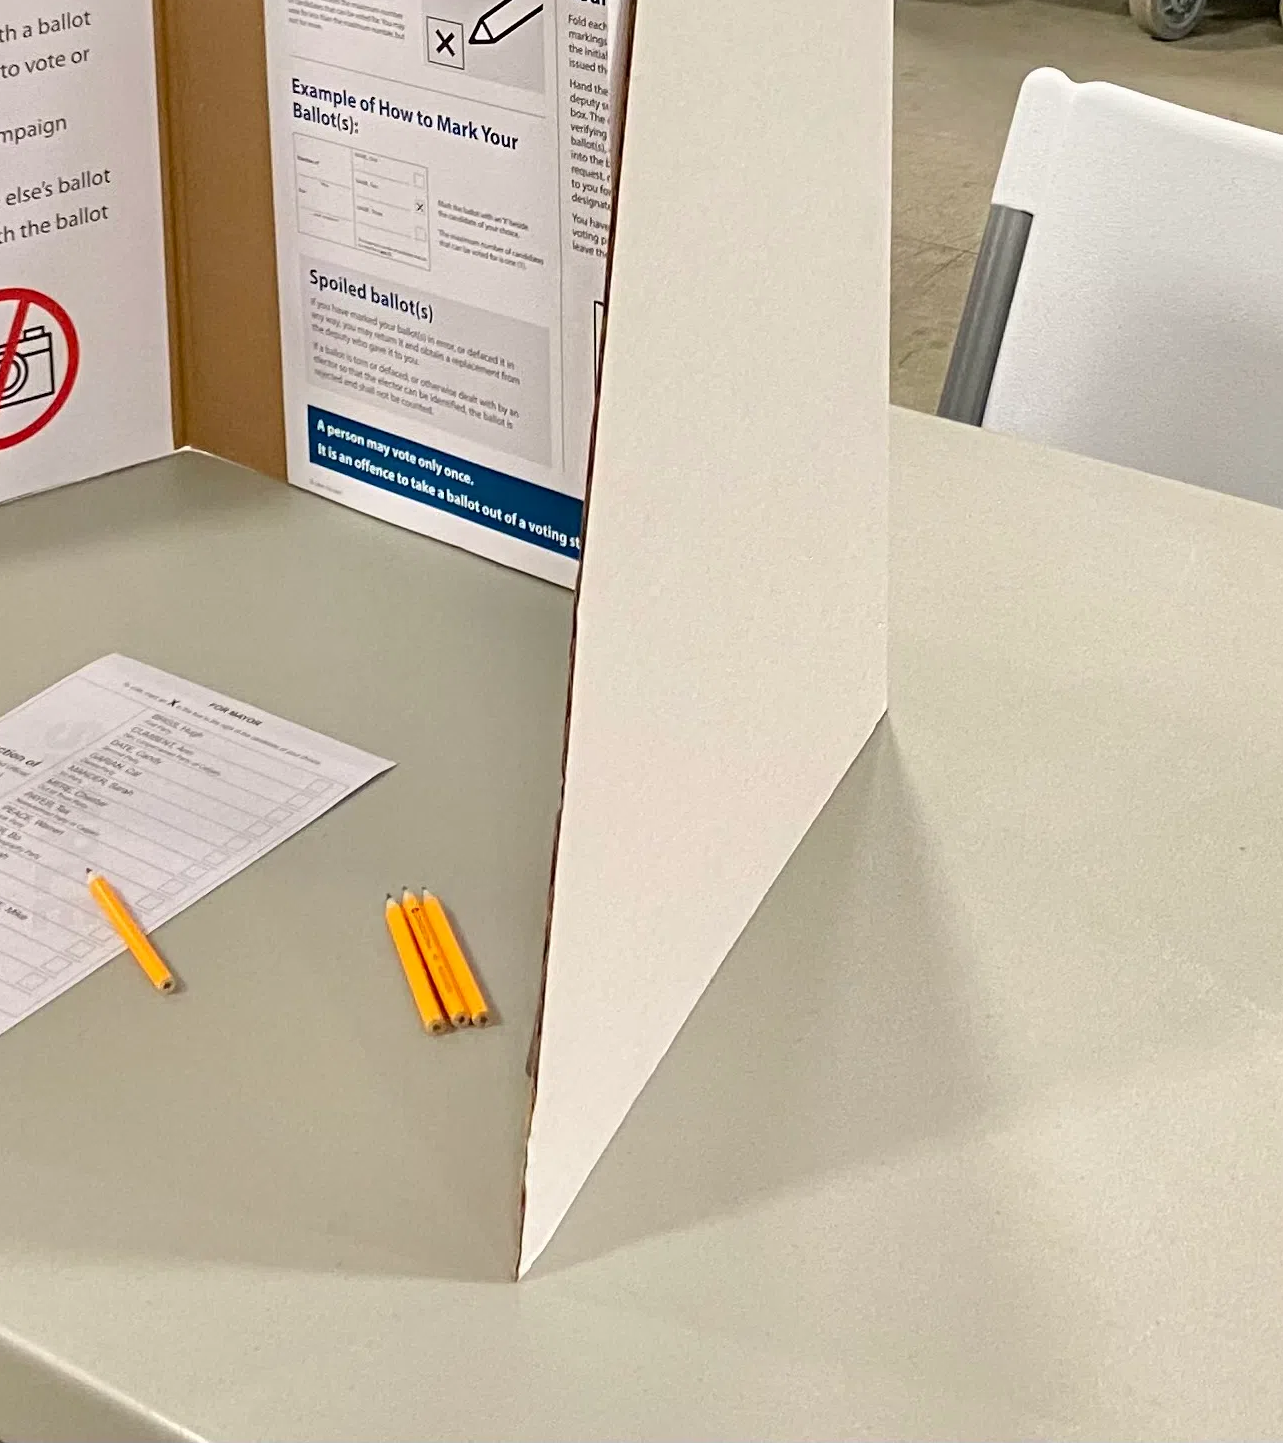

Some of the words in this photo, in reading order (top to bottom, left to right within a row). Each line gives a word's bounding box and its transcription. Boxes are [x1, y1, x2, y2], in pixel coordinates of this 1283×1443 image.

[21, 24, 33, 39] a
[37, 10, 92, 35] ballot
[568, 14, 586, 27] Fold
[23, 53, 66, 74] vote
[69, 47, 90, 65] or
[569, 79, 592, 93] Hand
[594, 84, 608, 96] the
[291, 77, 357, 108] Example
[358, 96, 376, 113] of
[378, 99, 414, 122] How
[415, 110, 433, 127] to
[436, 114, 479, 140] Mark
[479, 125, 519, 149] Your
[570, 93, 600, 111] deputy
[292, 101, 359, 134] Ballot(s):
[590, 111, 605, 124] The
[570, 123, 607, 141] verifying
[4, 179, 54, 206] else's
[57, 168, 112, 194] ballot
[582, 182, 598, 195] you
[18, 219, 51, 239] the
[54, 204, 109, 230] ballot
[572, 213, 587, 227] You
[572, 228, 599, 245] voting
[308, 269, 367, 299] Spoiled
[369, 286, 433, 323] ballot(s)
[315, 419, 328, 432] A
[325, 424, 365, 446] person
[365, 438, 391, 457] may
[390, 447, 418, 464] vote
[416, 457, 443, 475] only
[442, 466, 475, 485] once.
[316, 442, 327, 456] It
[326, 445, 338, 460] is
[337, 453, 353, 466] an
[353, 458, 396, 482] offence
[395, 472, 410, 486] to
[409, 476, 436, 496] take
[436, 488, 446, 499] a
[445, 488, 481, 512] ballot
[480, 505, 503, 521] out
[503, 512, 518, 526] of
[517, 518, 527, 529] a
[527, 521, 570, 547] voting
[568, 536, 580, 549] st
[208, 702, 229, 715] FOR
[228, 710, 264, 727] MAYOR
[25, 759, 42, 769] of
